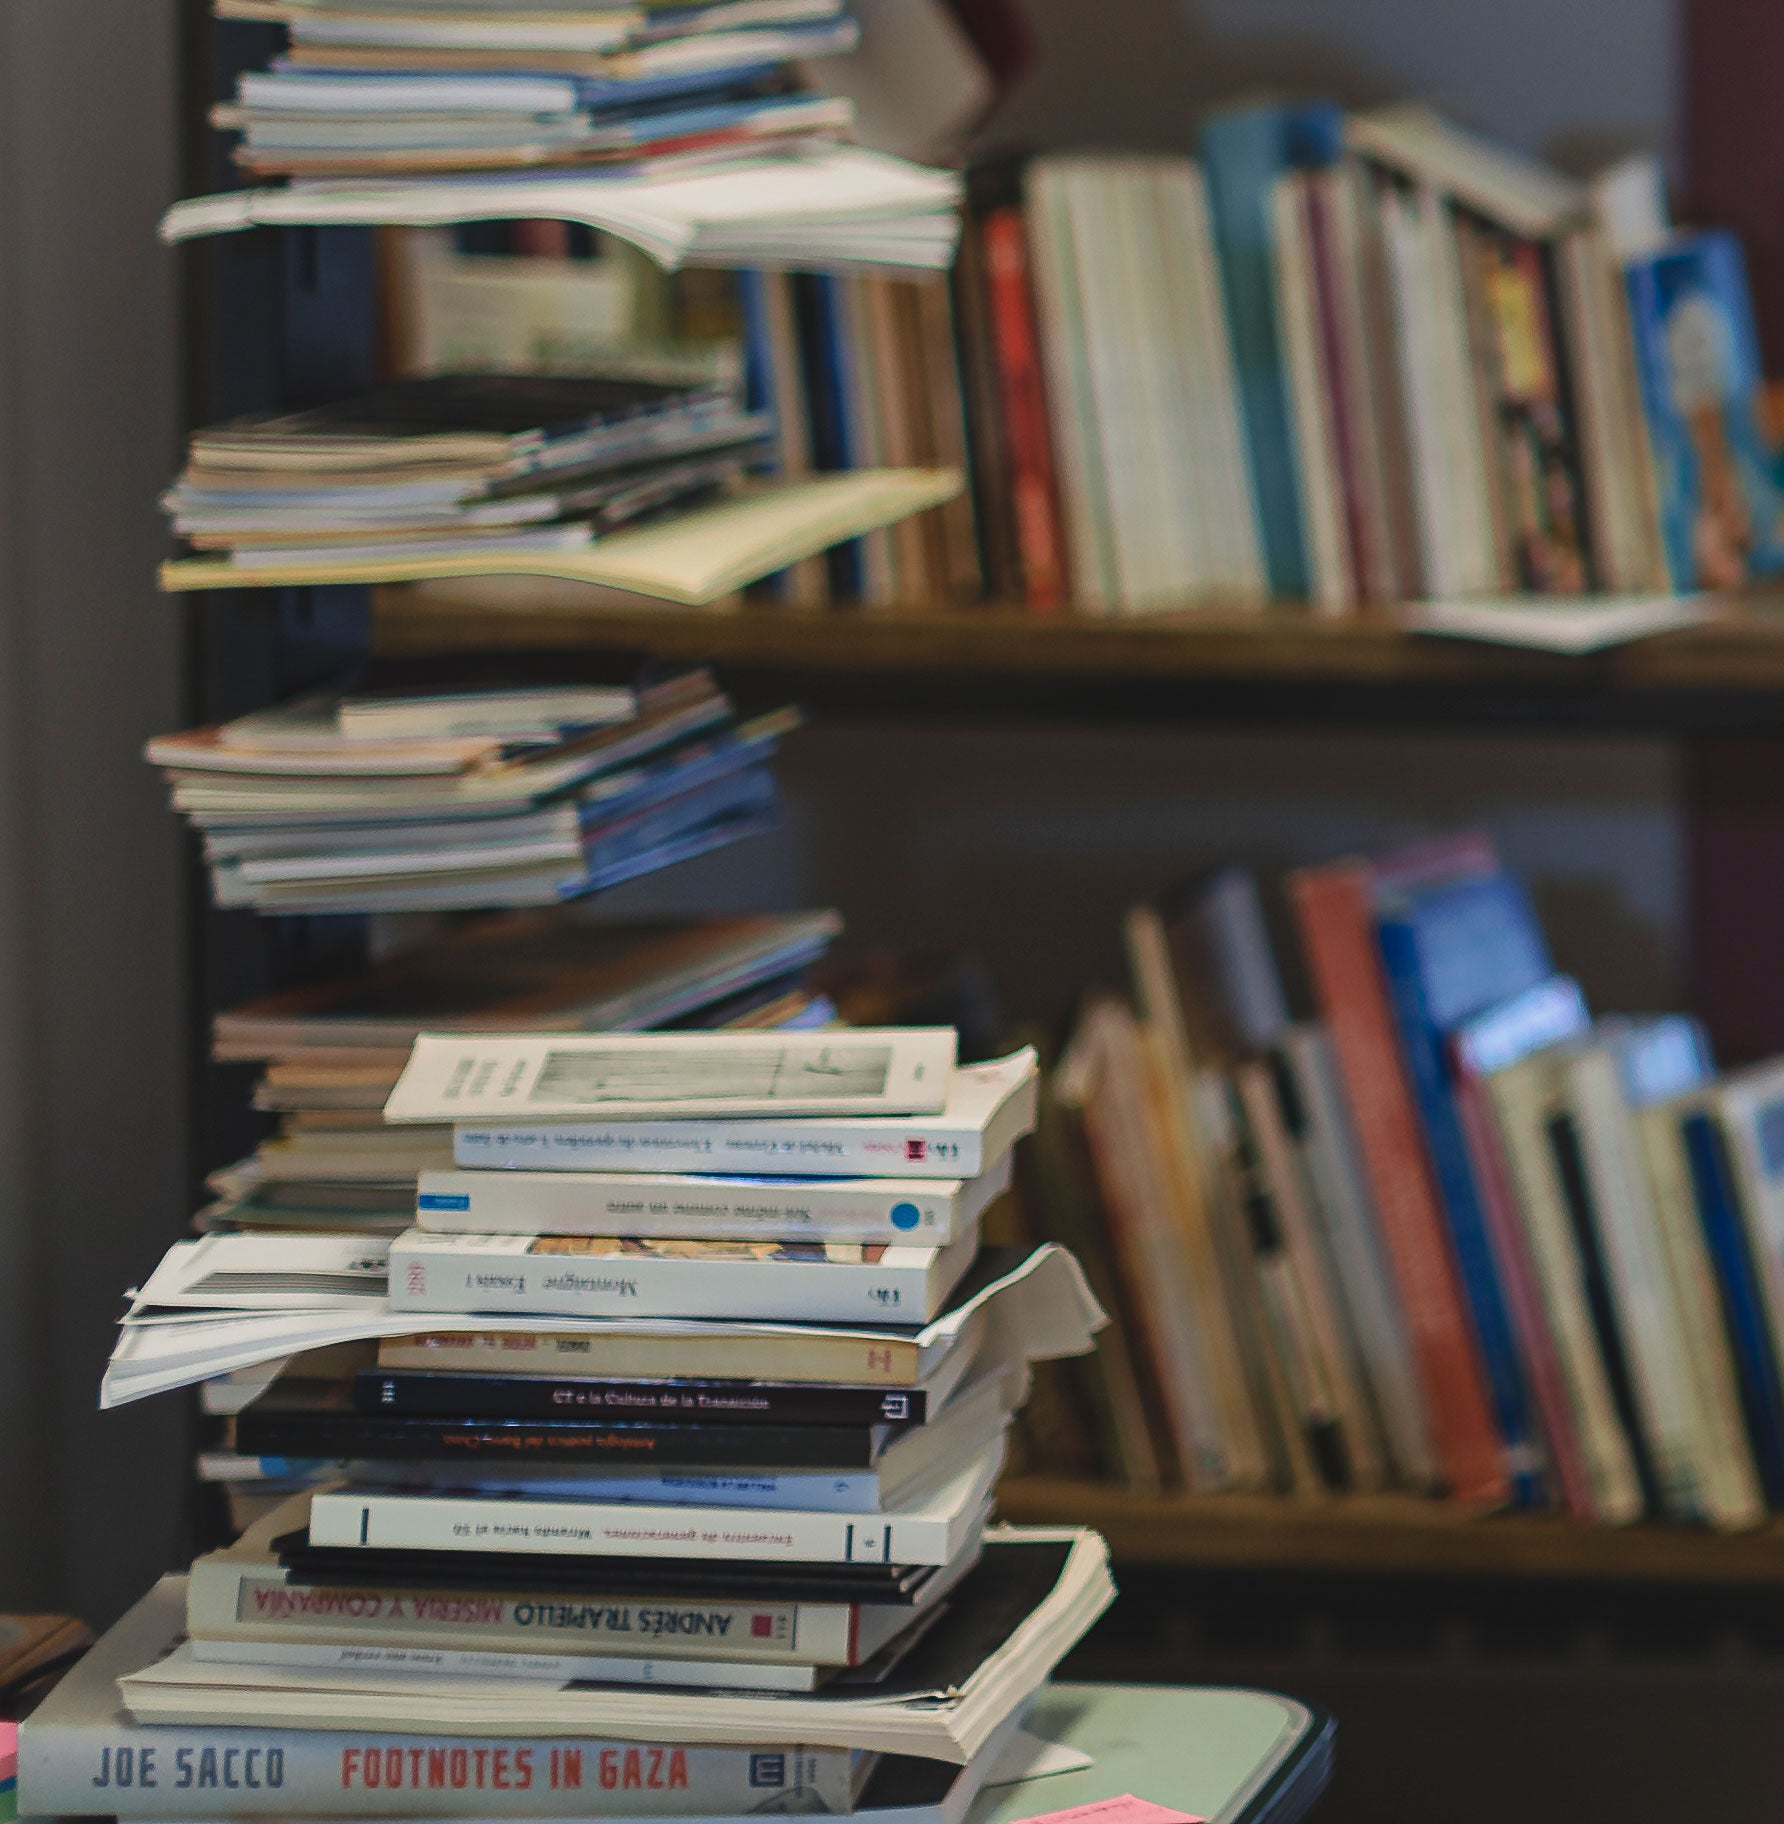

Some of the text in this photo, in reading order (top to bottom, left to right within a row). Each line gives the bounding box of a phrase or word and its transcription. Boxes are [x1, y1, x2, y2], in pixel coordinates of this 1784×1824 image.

[542, 1272, 638, 1296] Montaigne
[254, 1588, 733, 1638] ANDRÉS TRAPIELLO MISERIA Y COMPAÑÍA
[92, 1746, 690, 1790] JOE SACCO FOOTNOTES IN GAZA
